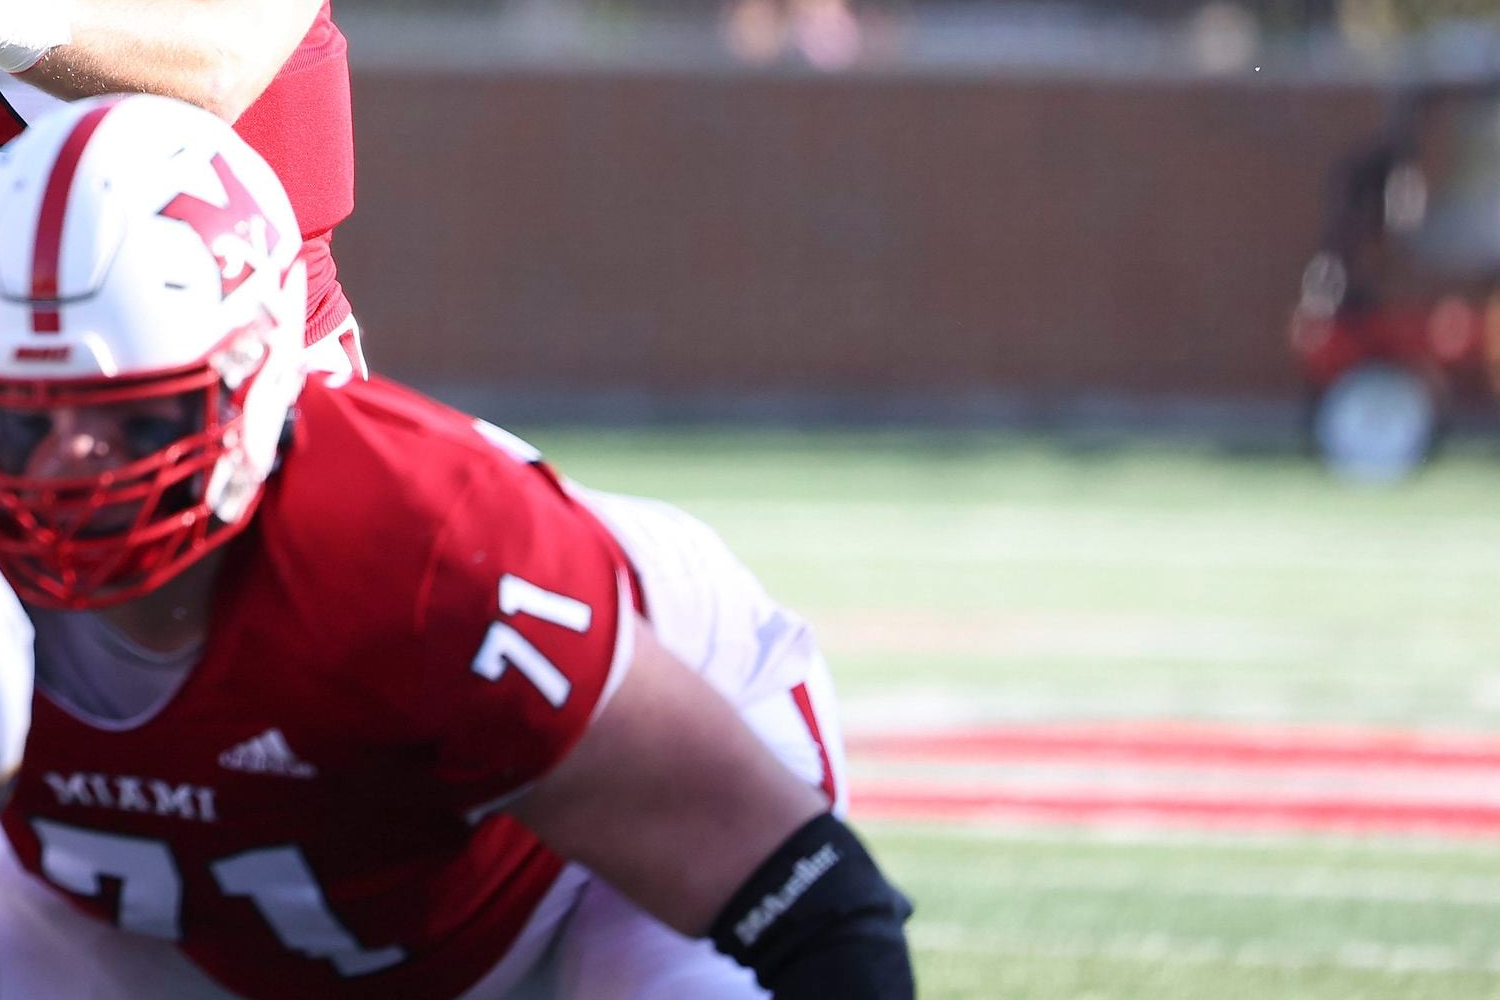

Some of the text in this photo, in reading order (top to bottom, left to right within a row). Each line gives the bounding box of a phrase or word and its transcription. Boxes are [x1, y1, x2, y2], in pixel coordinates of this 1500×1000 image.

[471, 572, 592, 709] 71
[44, 771, 219, 823] MIAMI
[29, 816, 410, 979] 71
